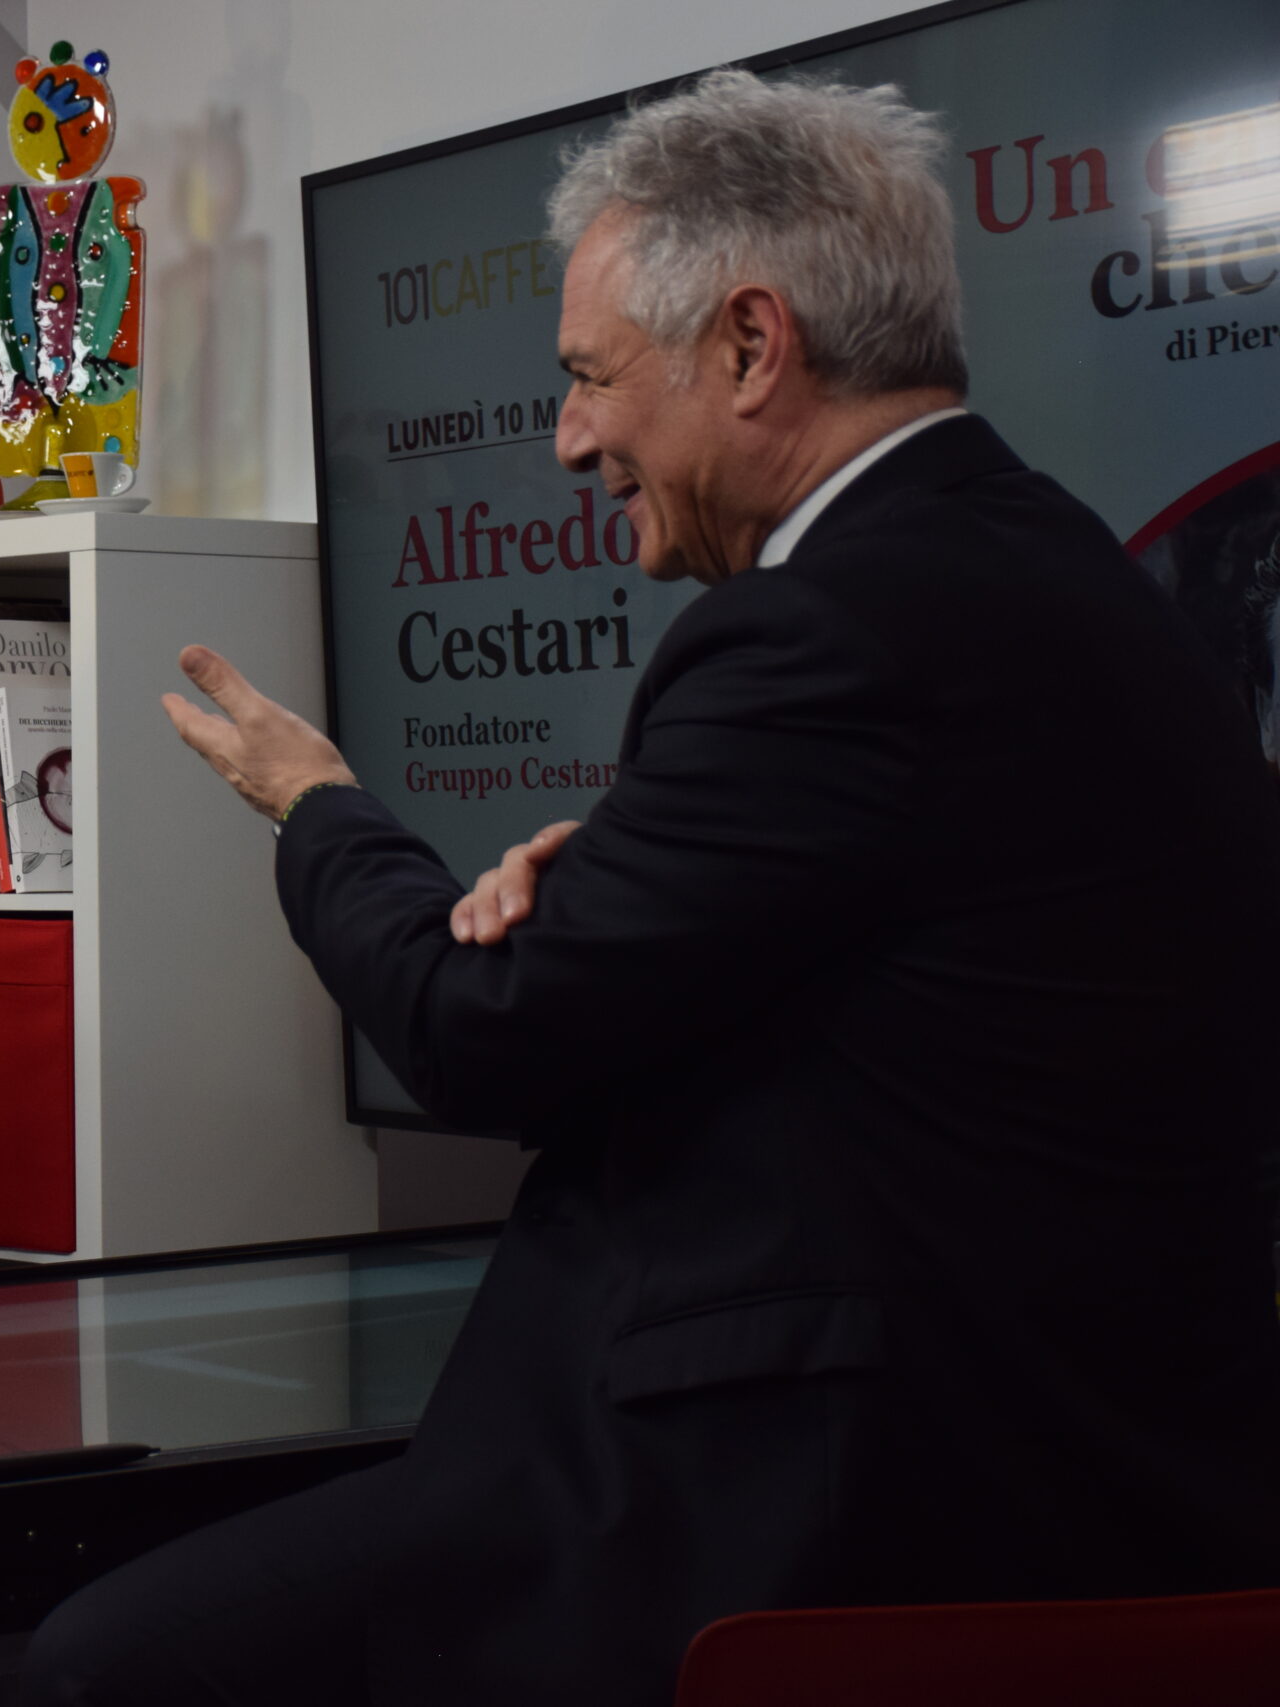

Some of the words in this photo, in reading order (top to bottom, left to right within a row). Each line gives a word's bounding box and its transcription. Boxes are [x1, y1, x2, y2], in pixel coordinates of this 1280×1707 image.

[966, 134, 1115, 234] Un
[1165, 328, 1198, 361] di
[1206, 321, 1280, 356] Pier
[387, 400, 485, 453] LUNEDÌ
[493, 402, 524, 436] 10
[391, 487, 640, 588] Alfredo
[398, 587, 635, 684] Cestari
[404, 712, 551, 748] Fondatore
[405, 761, 512, 800] Gruppo
[521, 757, 620, 790] Cestar
